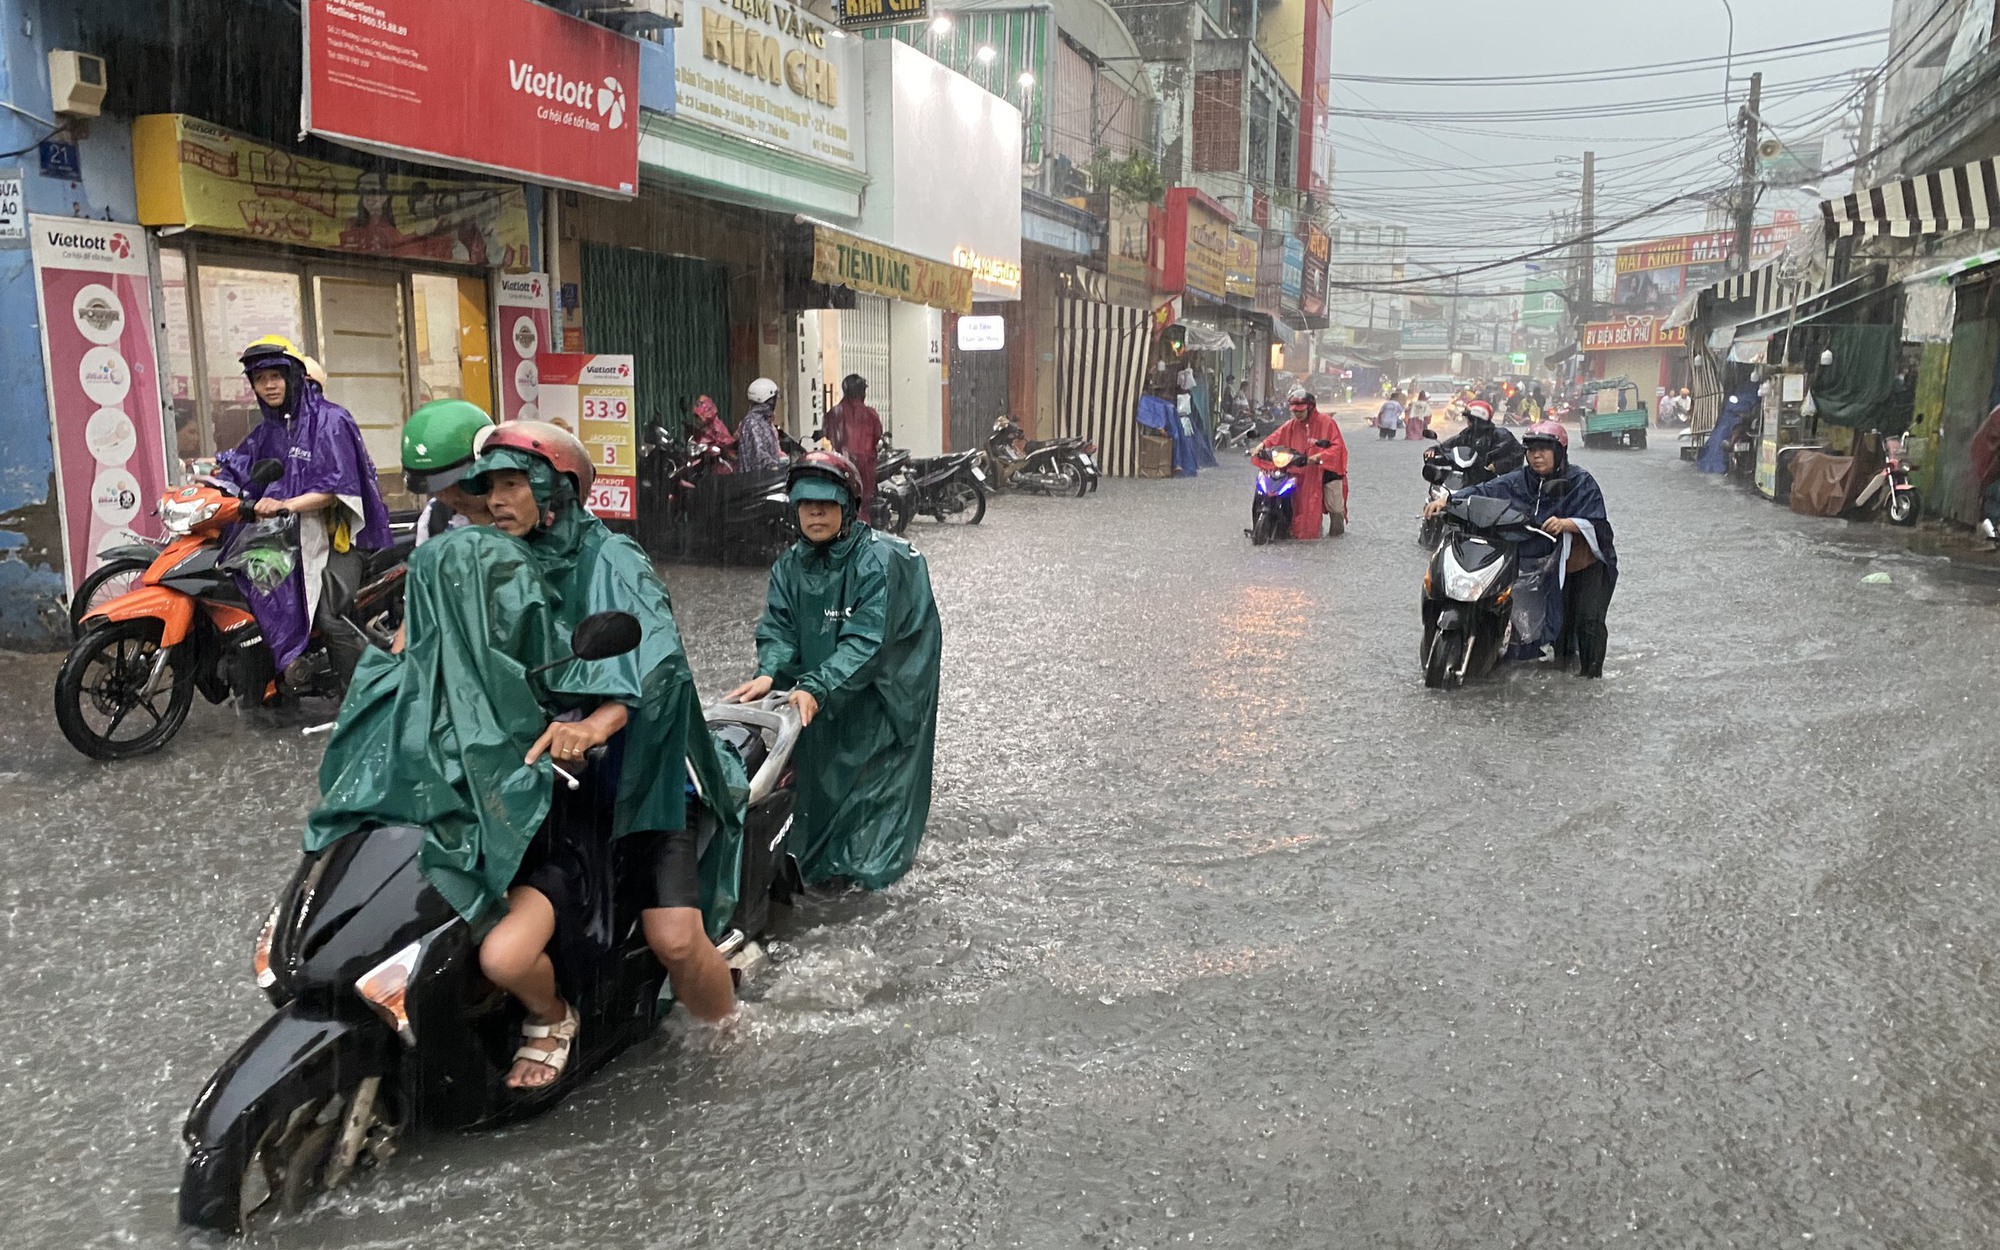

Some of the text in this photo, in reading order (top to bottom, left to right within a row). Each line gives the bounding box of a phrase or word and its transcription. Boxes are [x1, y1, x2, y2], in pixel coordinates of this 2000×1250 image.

[326, 4, 408, 36] Hotline: 1900.55.88.89
[774, 4, 827, 49] VÀNG
[703, 6, 838, 109] KIM CHI
[508, 58, 594, 110] Vietlott
[537, 105, 600, 132] Cơ hội để tốt hơn
[50, 144, 68, 164] 21
[48, 231, 105, 250] Vietlott
[1692, 233, 1733, 261] MẮT
[1647, 240, 1681, 267] KÍNH
[837, 241, 874, 285] TIỆM
[874, 247, 911, 292] VÀNG
[502, 280, 530, 292] Vietlott
[1616, 325, 1633, 344] BIÊN
[931, 340, 938, 353] 25
[587, 366, 617, 375] Vietlott
[590, 388, 621, 396] JACKPOT
[591, 434, 621, 442] JACKPOT
[605, 447, 616, 464] 3
[594, 478, 625, 486] JACKPOT
